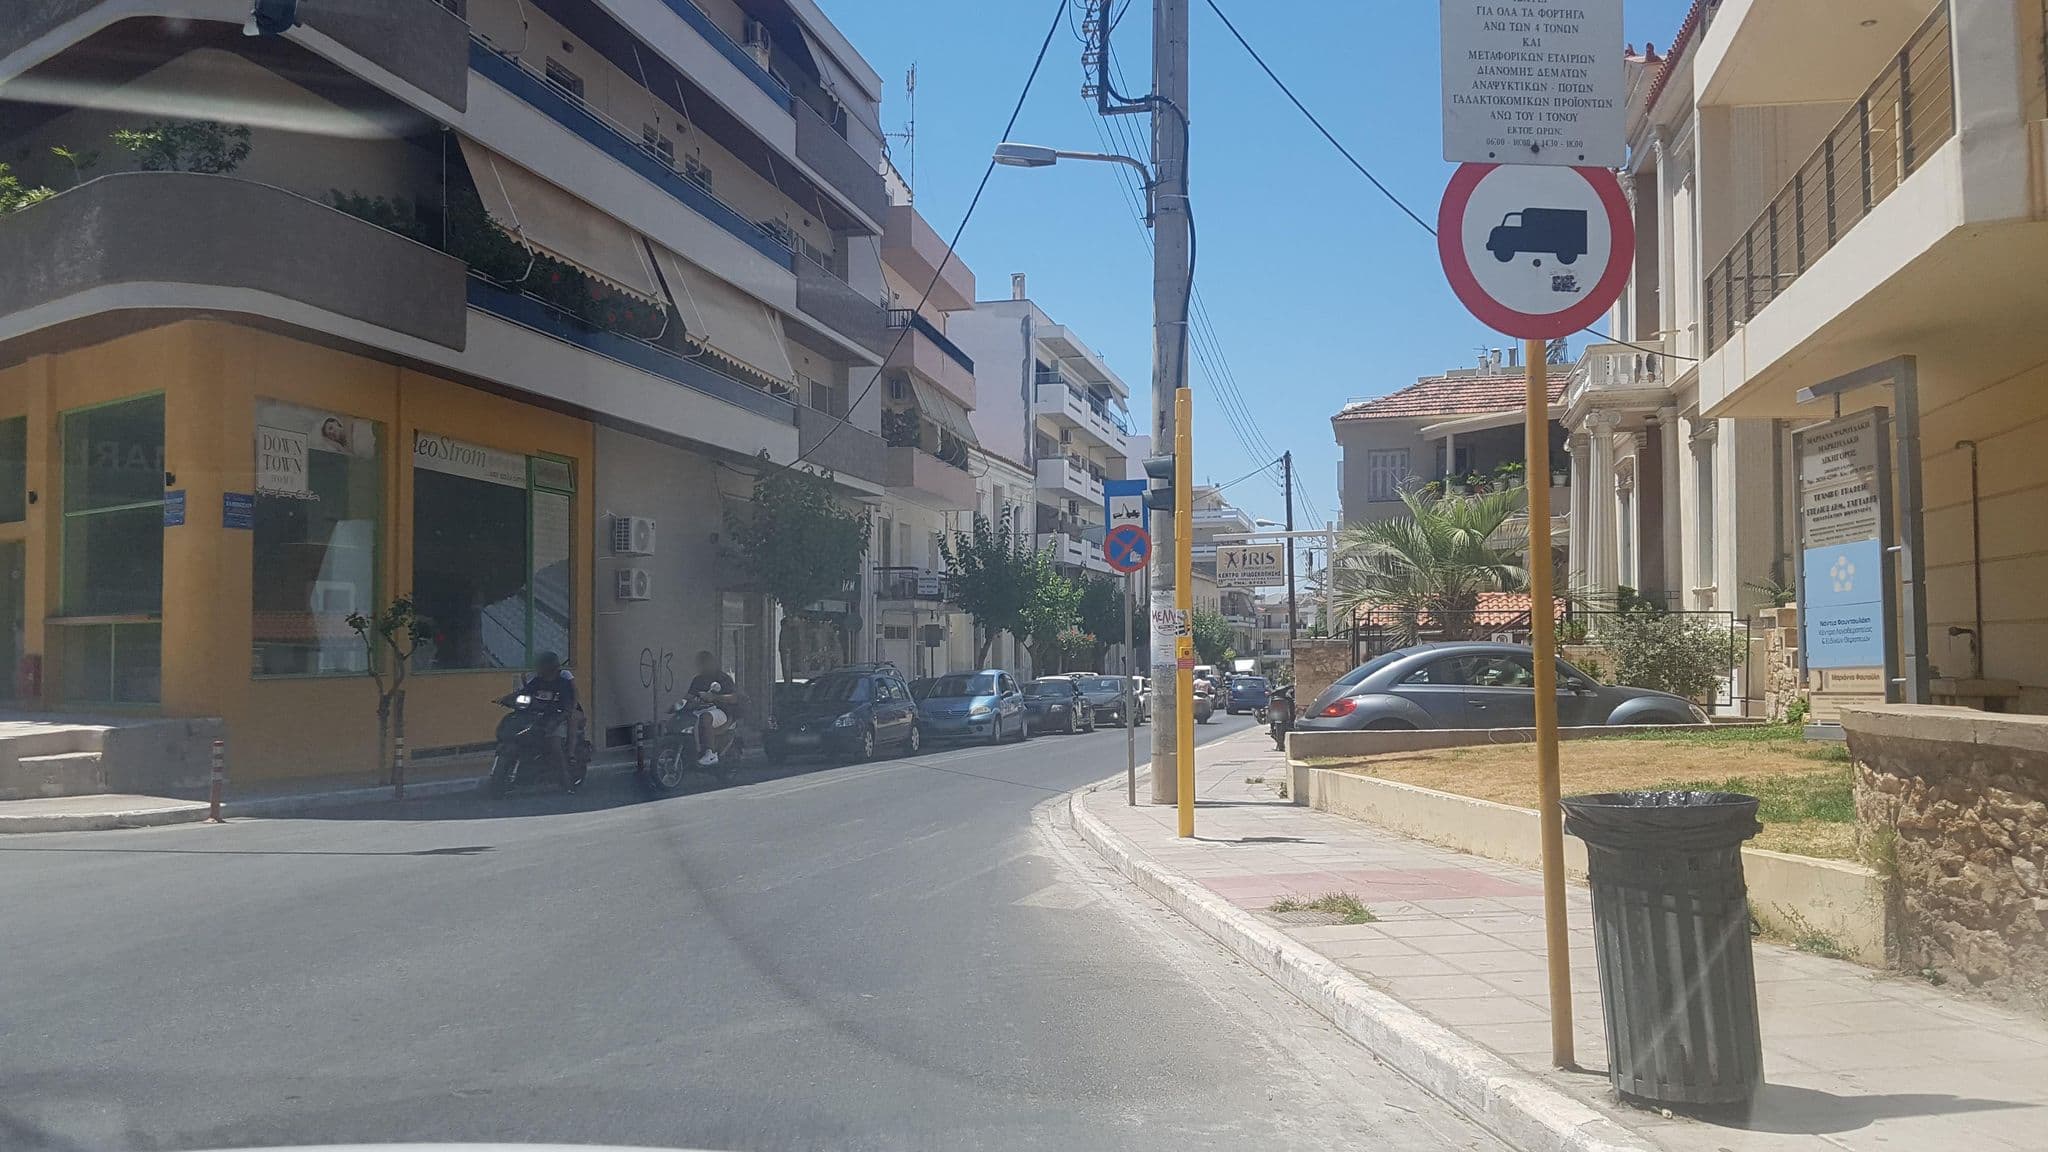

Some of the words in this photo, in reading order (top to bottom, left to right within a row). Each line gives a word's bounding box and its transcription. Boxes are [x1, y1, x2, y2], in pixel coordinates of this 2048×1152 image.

[1477, 6, 1493, 16] ΓΙΑ
[1497, 7, 1517, 17] ΟΛΑ
[1522, 8, 1534, 17] ΤΑ
[1538, 8, 1585, 19] ΦΟΡΤΗΓΑ
[1483, 22, 1506, 31] ΑΝΩ
[1509, 23, 1531, 32] ΤΩΝ
[1535, 24, 1540, 32] 4
[1543, 24, 1579, 33] ΤΟΝΩΝ
[1522, 38, 1541, 47] ΚΑΙ
[1468, 51, 1544, 62] ΜΕΤΑΦΟΡΙΚΩΝ
[1547, 54, 1595, 63] ΕΤΑΙΡΙΩΝ
[1477, 66, 1533, 76] ΔΙΑΝΟΜΗΣ
[1537, 68, 1587, 78] ΔΕΜΑΤΩΝ
[1471, 80, 1548, 92] ΑΝΑΨΥΚΤΙΚΩΝ
[1558, 83, 1594, 92] ΠΟΤΩΝ
[1453, 94, 1550, 106] ΓΑΛΑΚΤΟΚΟΜΙΚΩΝ
[1490, 111, 1512, 120] ΑΝΩ
[1515, 112, 1534, 121] ΤΟΥ
[1538, 113, 1542, 121] 1
[1546, 113, 1579, 122] ΤΟΝΟΥ
[1507, 127, 1534, 135] ΕΚΤΟΣ
[263, 434, 302, 455] DOWN
[263, 453, 302, 473] TOWN
